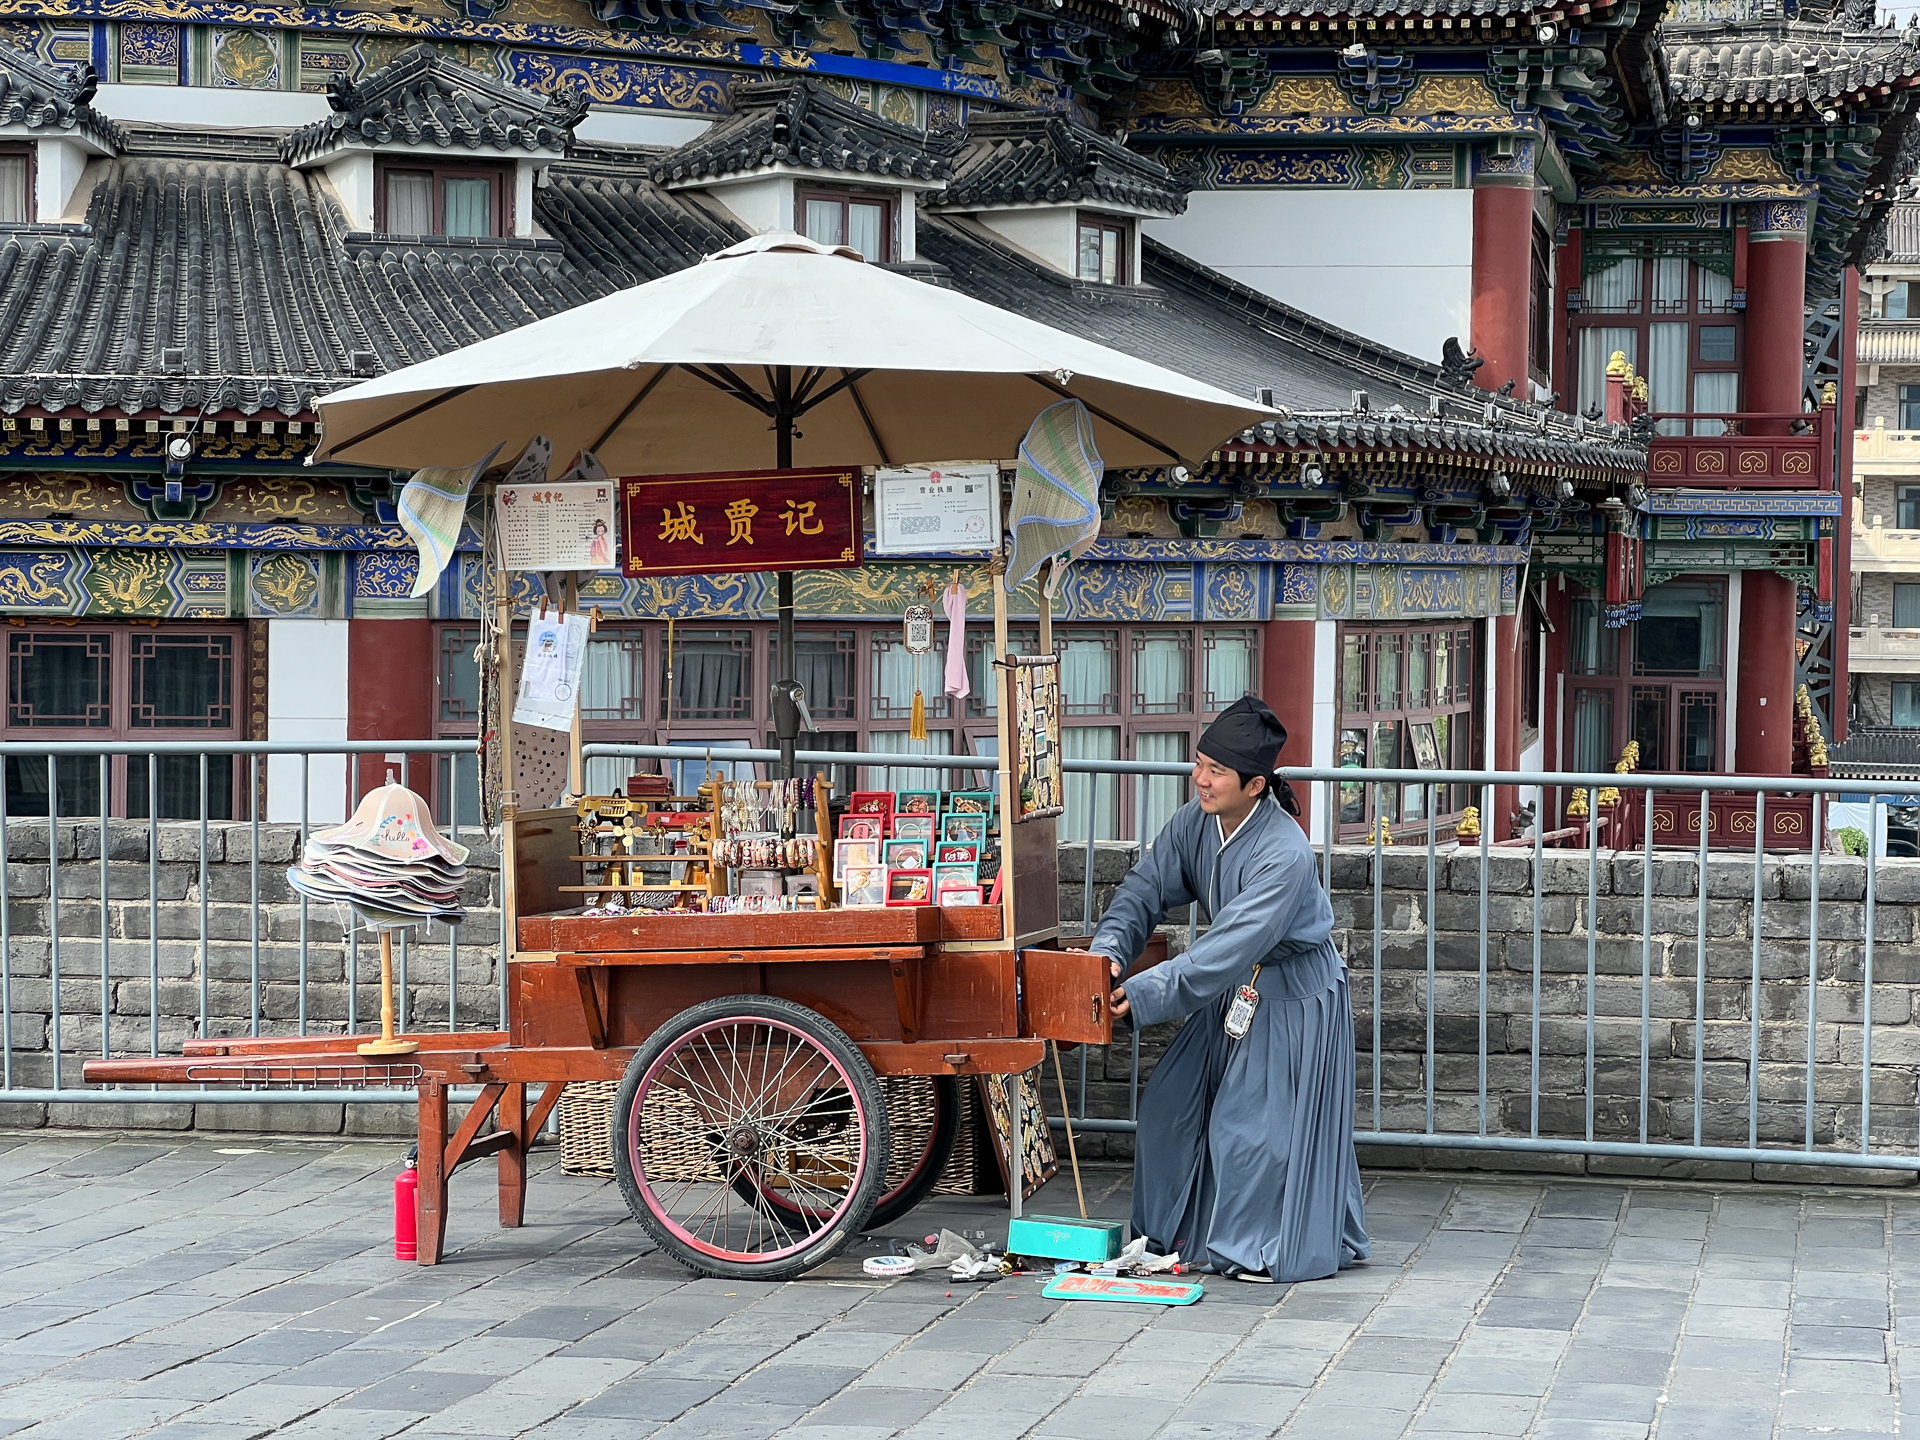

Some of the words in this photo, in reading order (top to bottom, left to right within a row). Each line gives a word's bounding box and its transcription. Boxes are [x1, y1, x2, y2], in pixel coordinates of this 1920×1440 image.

[919, 485, 953, 494] 营业执照
[657, 498, 824, 546] 城贾记
[381, 829, 410, 842] hello
